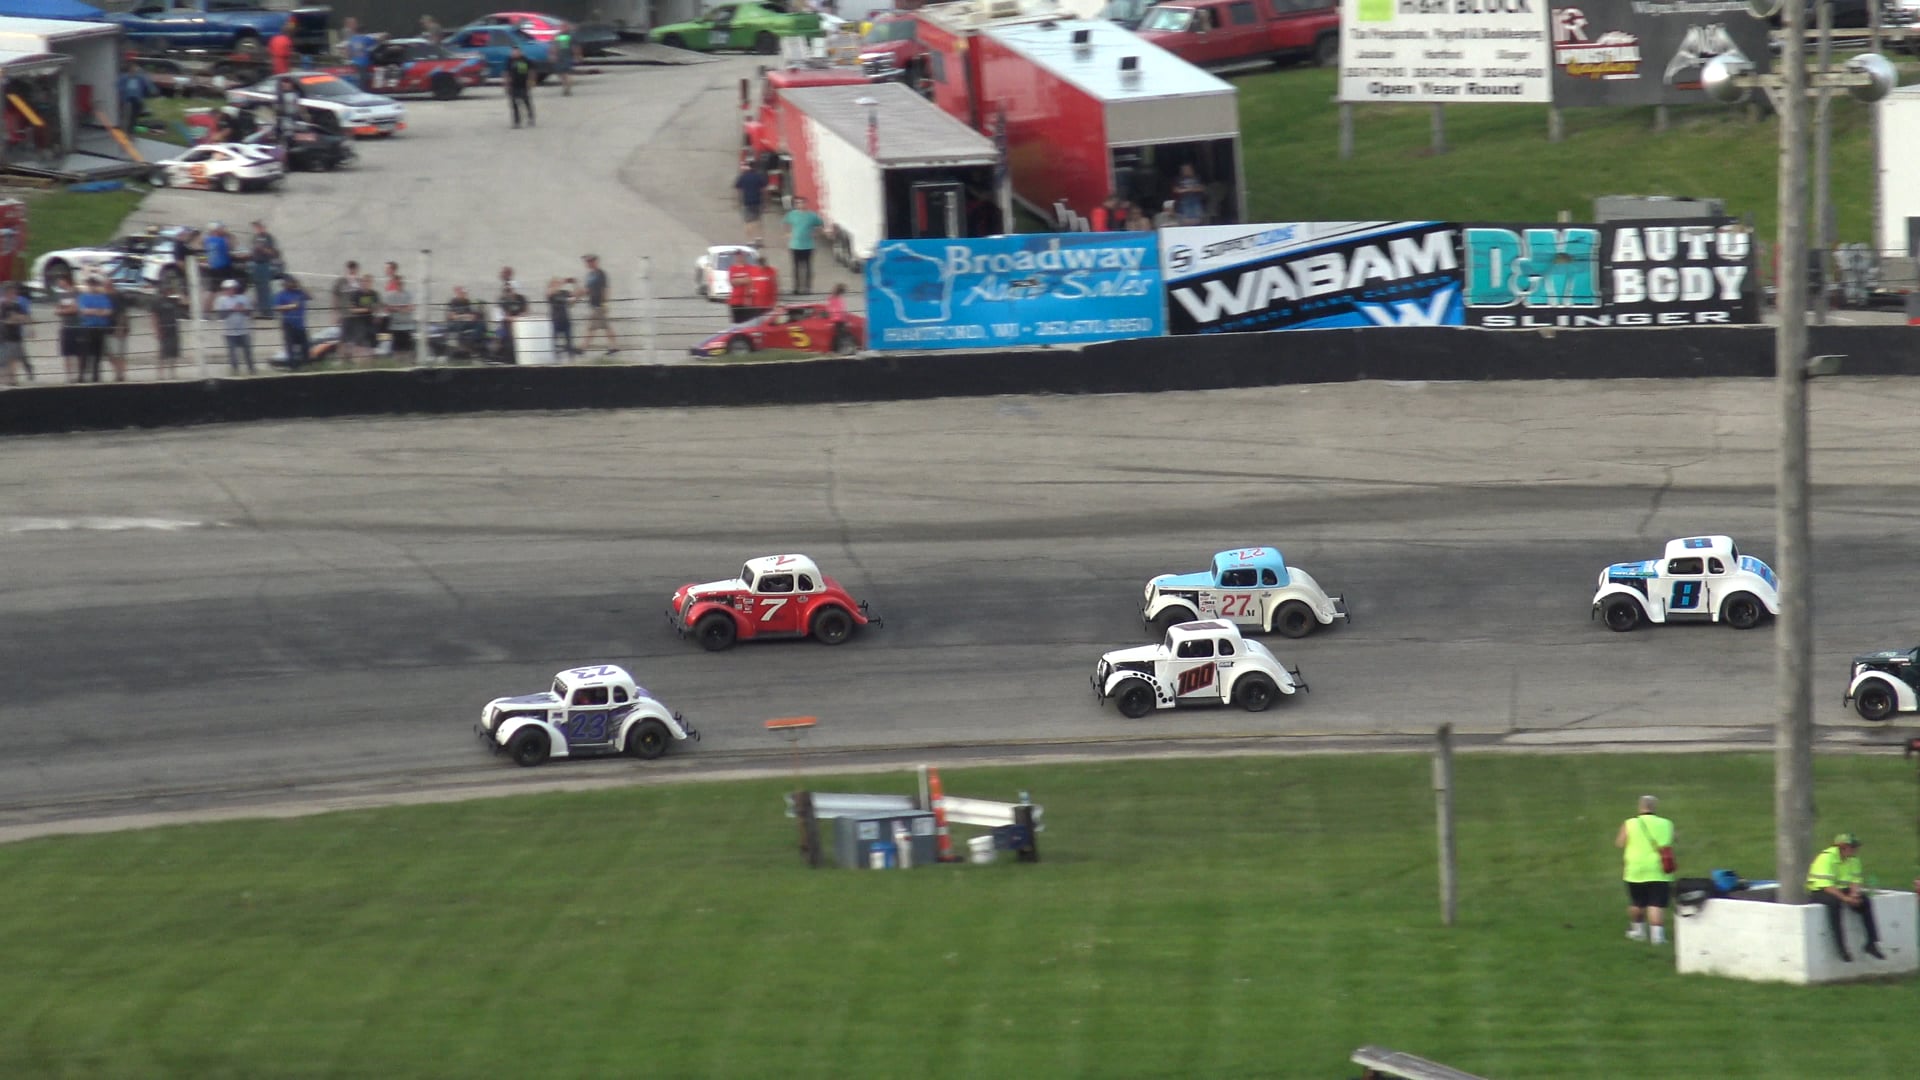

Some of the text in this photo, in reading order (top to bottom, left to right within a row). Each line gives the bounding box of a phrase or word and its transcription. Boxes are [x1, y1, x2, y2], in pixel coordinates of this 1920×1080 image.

[1368, 81, 1523, 97] Open Year Round
[944, 238, 1147, 276] Broadway
[1611, 225, 1750, 262] AUTO
[1054, 268, 1152, 299] Sales
[1170, 230, 1458, 323] WABAM
[1463, 228, 1602, 308] D&M
[1612, 266, 1748, 303] BODY
[1482, 311, 1730, 327] SLINGER
[788, 326, 812, 348] 5
[760, 598, 788, 622] 7
[1670, 580, 1702, 609] 8
[1177, 661, 1216, 697] 100
[571, 712, 607, 739] 23
